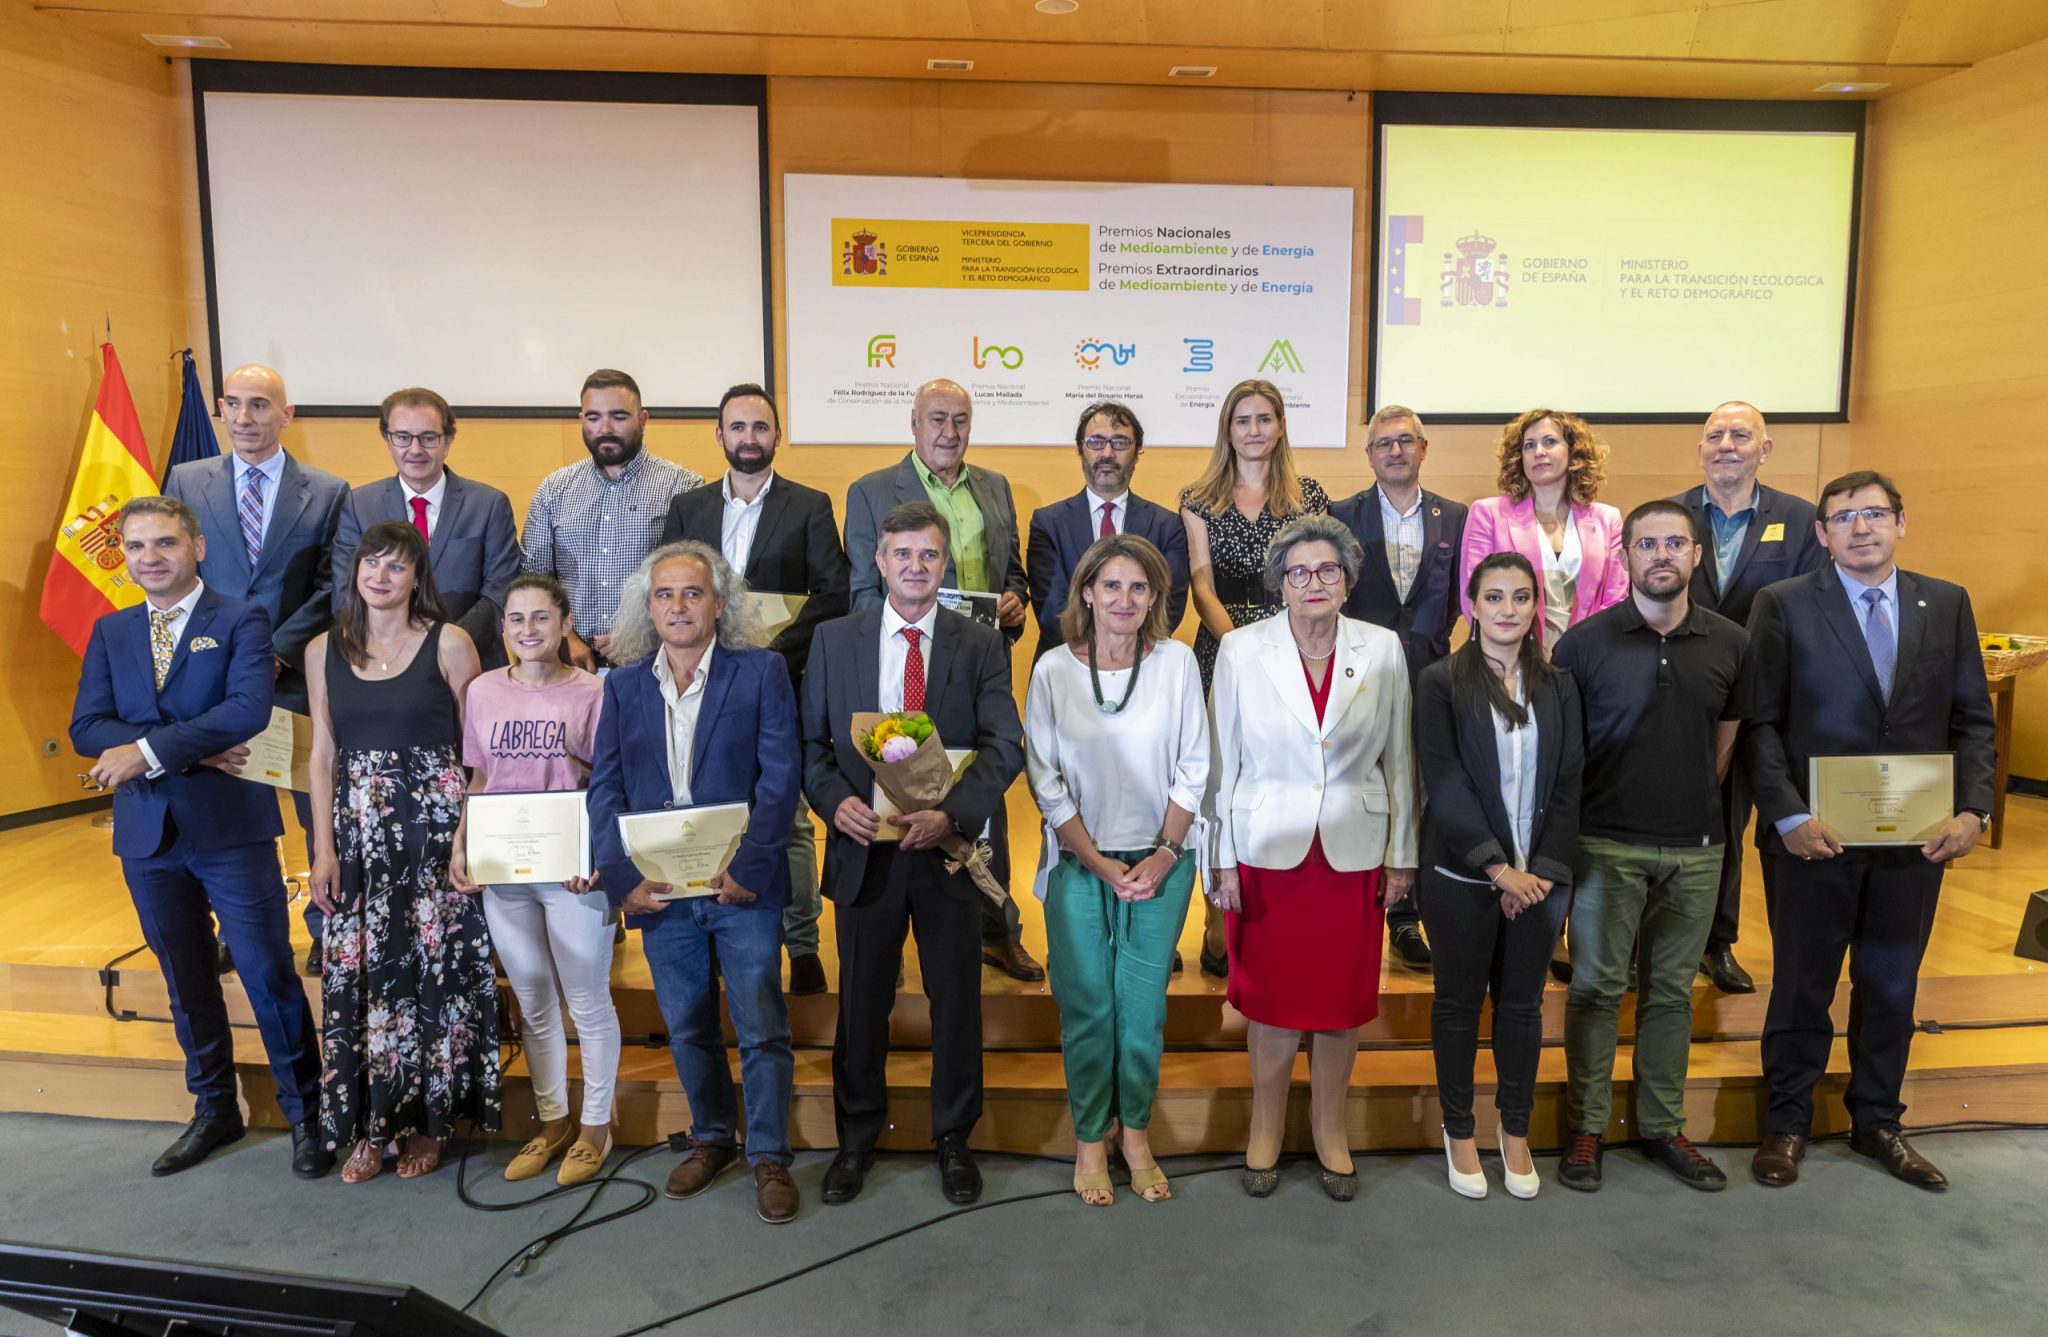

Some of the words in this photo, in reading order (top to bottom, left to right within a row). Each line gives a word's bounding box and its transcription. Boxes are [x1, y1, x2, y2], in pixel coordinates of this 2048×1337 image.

[961, 229, 1026, 238] VICEPRESIDENCIA
[1099, 225, 1153, 237] Premios
[1157, 226, 1231, 239] Nacionales
[896, 244, 940, 253] GOBIERNO
[962, 238, 995, 246] TERCERA
[997, 239, 1010, 247] DEL
[1013, 239, 1053, 248] GOBIERNO
[1099, 241, 1116, 253] de
[1120, 242, 1228, 255] Medioambiente
[1230, 246, 1239, 258] y
[1242, 244, 1259, 256] de
[1262, 245, 1314, 259] Energía
[896, 254, 907, 262] DE
[909, 253, 940, 263] ESPAÑA
[961, 256, 1002, 264] MINISTERIO
[1522, 258, 1589, 269] GOBIERNO
[961, 265, 980, 273] PARA
[992, 265, 1035, 274] TRANSICIÓN
[1036, 266, 1079, 275] ECOLÓGICA
[1098, 262, 1153, 275] Premios
[1156, 263, 1259, 277] Extraordinarios
[1620, 259, 1689, 271] MINISTERIO
[998, 274, 1051, 283] DEMOGRÁFICO
[1522, 272, 1538, 283] DE
[1542, 270, 1587, 283] ESPAÑA
[1619, 273, 1651, 284] PARA
[1655, 274, 1669, 285] LA
[1674, 273, 1749, 286] TRANSICIÓN
[1752, 273, 1824, 286] ECOLÓGICA
[1099, 278, 1116, 290] de
[1119, 279, 1227, 292] Medioambiente
[1230, 283, 1239, 295] y
[1241, 281, 1258, 293] de
[1261, 281, 1313, 296] Energía
[1619, 287, 1628, 297] Y
[1631, 288, 1644, 298] EL
[1647, 288, 1680, 299] RETO
[1683, 287, 1773, 300] DEMOGRÁFICO
[851, 389, 887, 398] Rodríguez
[1189, 401, 1215, 409] Energía
[490, 720, 566, 750] LABREGA
